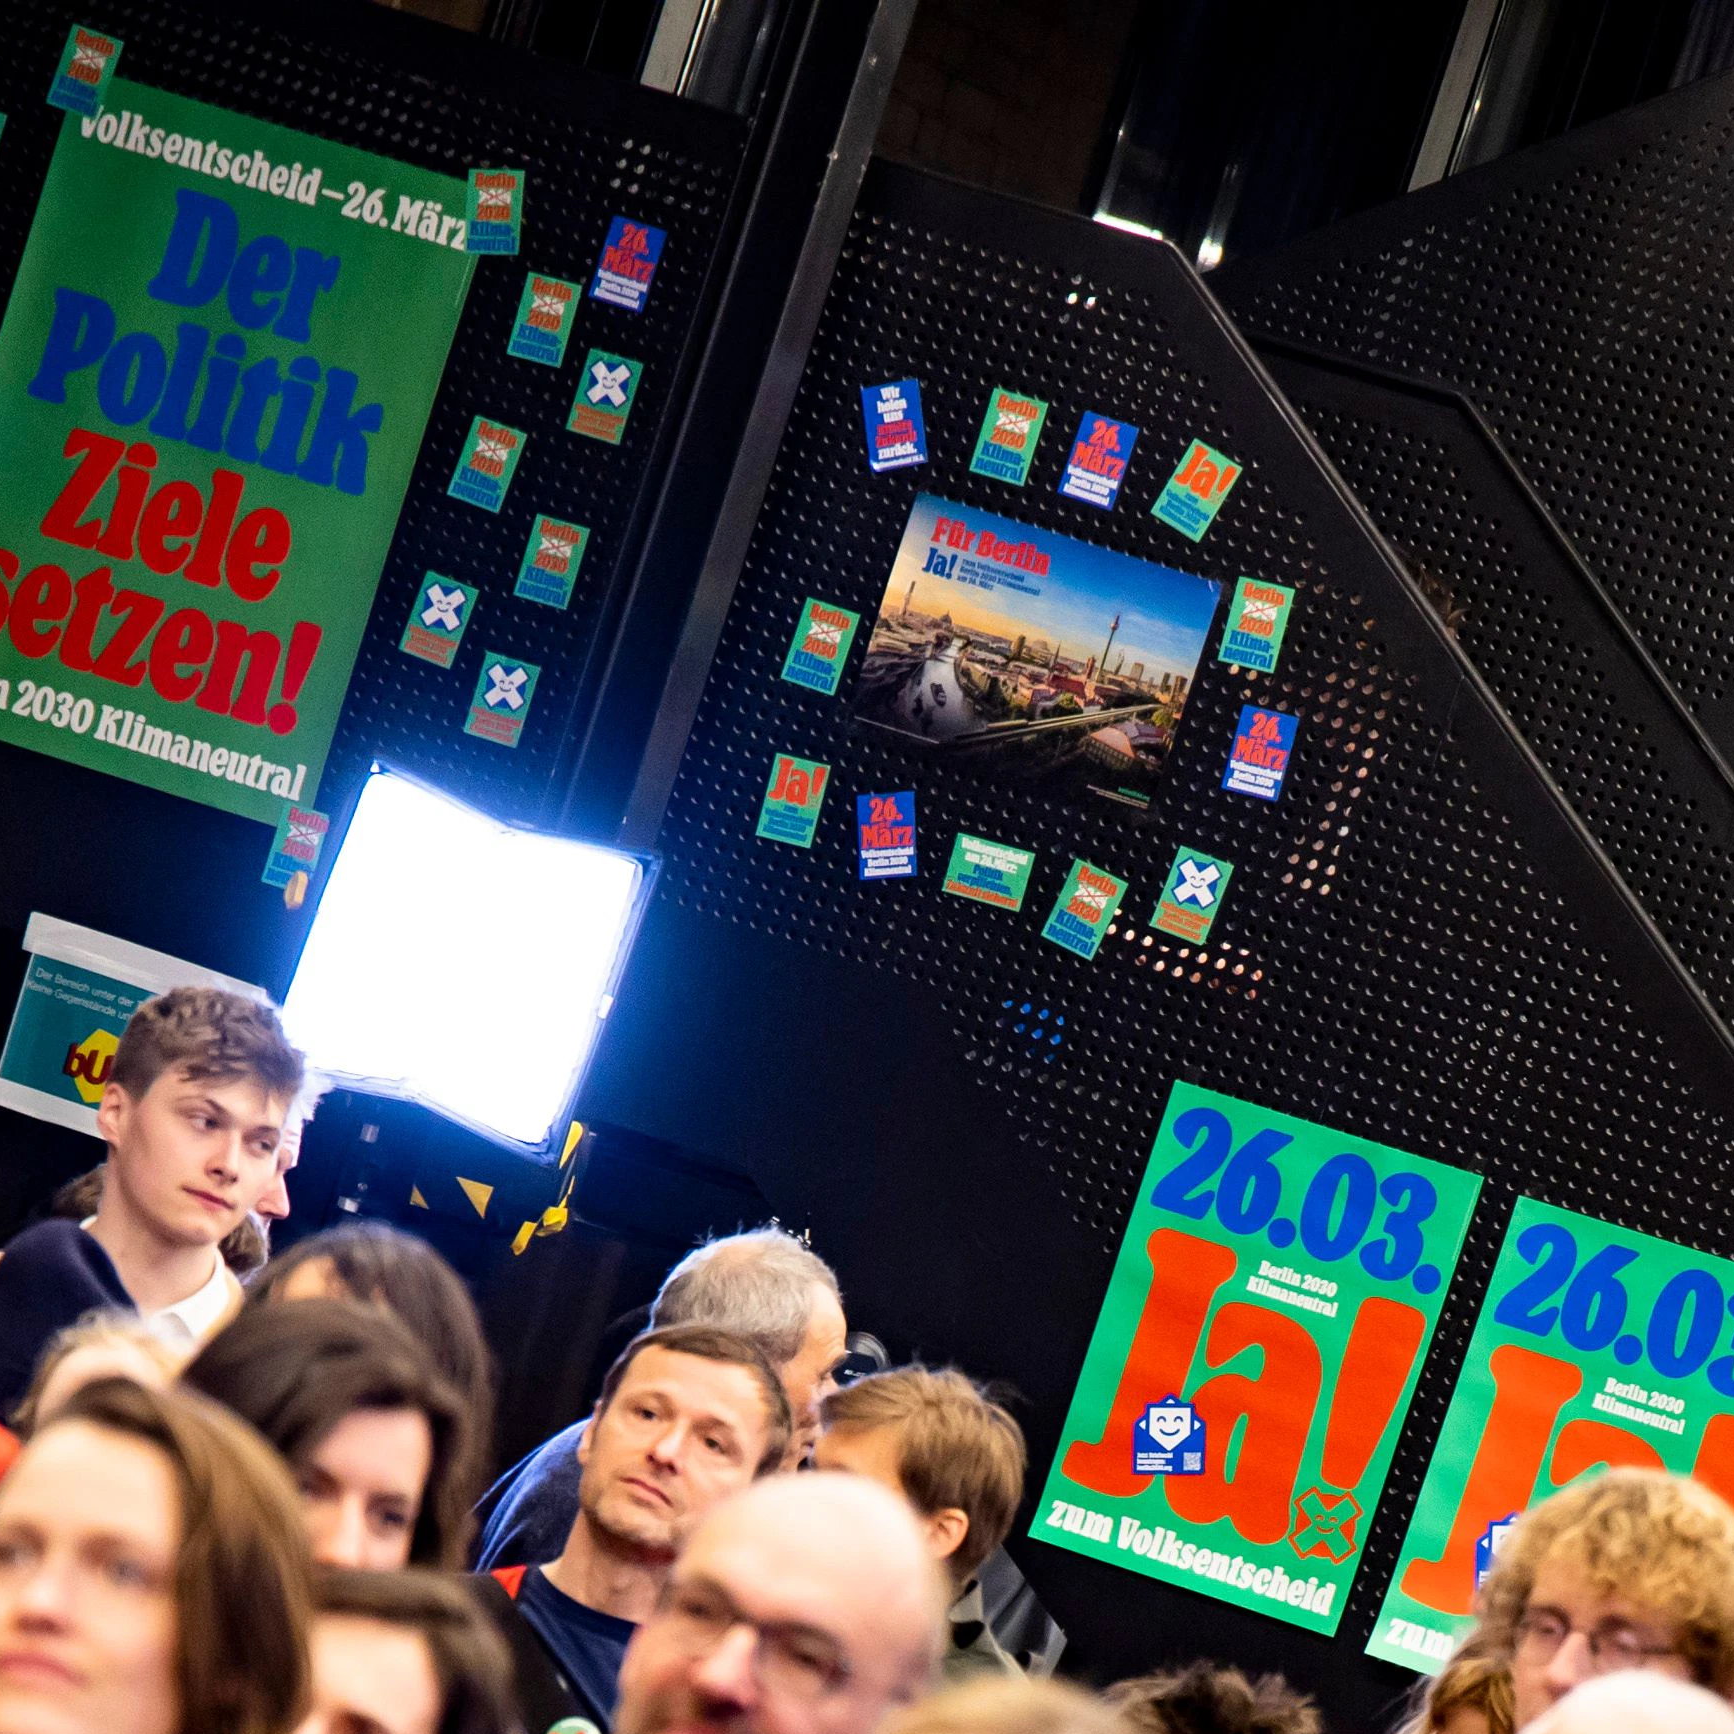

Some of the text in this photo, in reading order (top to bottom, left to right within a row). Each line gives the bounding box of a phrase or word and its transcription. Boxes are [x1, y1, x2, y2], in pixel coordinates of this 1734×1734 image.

[390, 194, 466, 252] März
[147, 187, 341, 344] Der
[26, 287, 383, 496] Politik
[996, 393, 1039, 419] Berlin
[1089, 418, 1119, 451] 26.
[1070, 442, 1125, 479] März
[1175, 445, 1237, 500] Ja!
[39, 427, 291, 602] Ziele
[922, 547, 958, 580] Ja!
[931, 516, 1051, 576] Für Berlin
[1242, 581, 1286, 605] Berlin
[809, 603, 851, 629] Berlin
[12, 679, 94, 734] 2030
[94, 704, 308, 802] Klimaneutral
[1249, 711, 1281, 742] 26.
[1232, 735, 1287, 770] März
[769, 759, 826, 806] Ja!
[871, 796, 902, 822] 26.
[860, 821, 912, 848] März
[1075, 865, 1119, 896] Berlin
[1150, 1107, 1441, 1295] 26.03.
[1246, 1275, 1339, 1318] Klimaneutral
[1258, 1260, 1338, 1297] Berlin 2030
[1061, 1227, 1427, 1545] Ja!
[1604, 1376, 1685, 1415] Berlin 2030
[1592, 1392, 1686, 1436] Klimaneutral
[1044, 1499, 1337, 1619] zum Volksentscheid
[1384, 1617, 1455, 1661] zum
